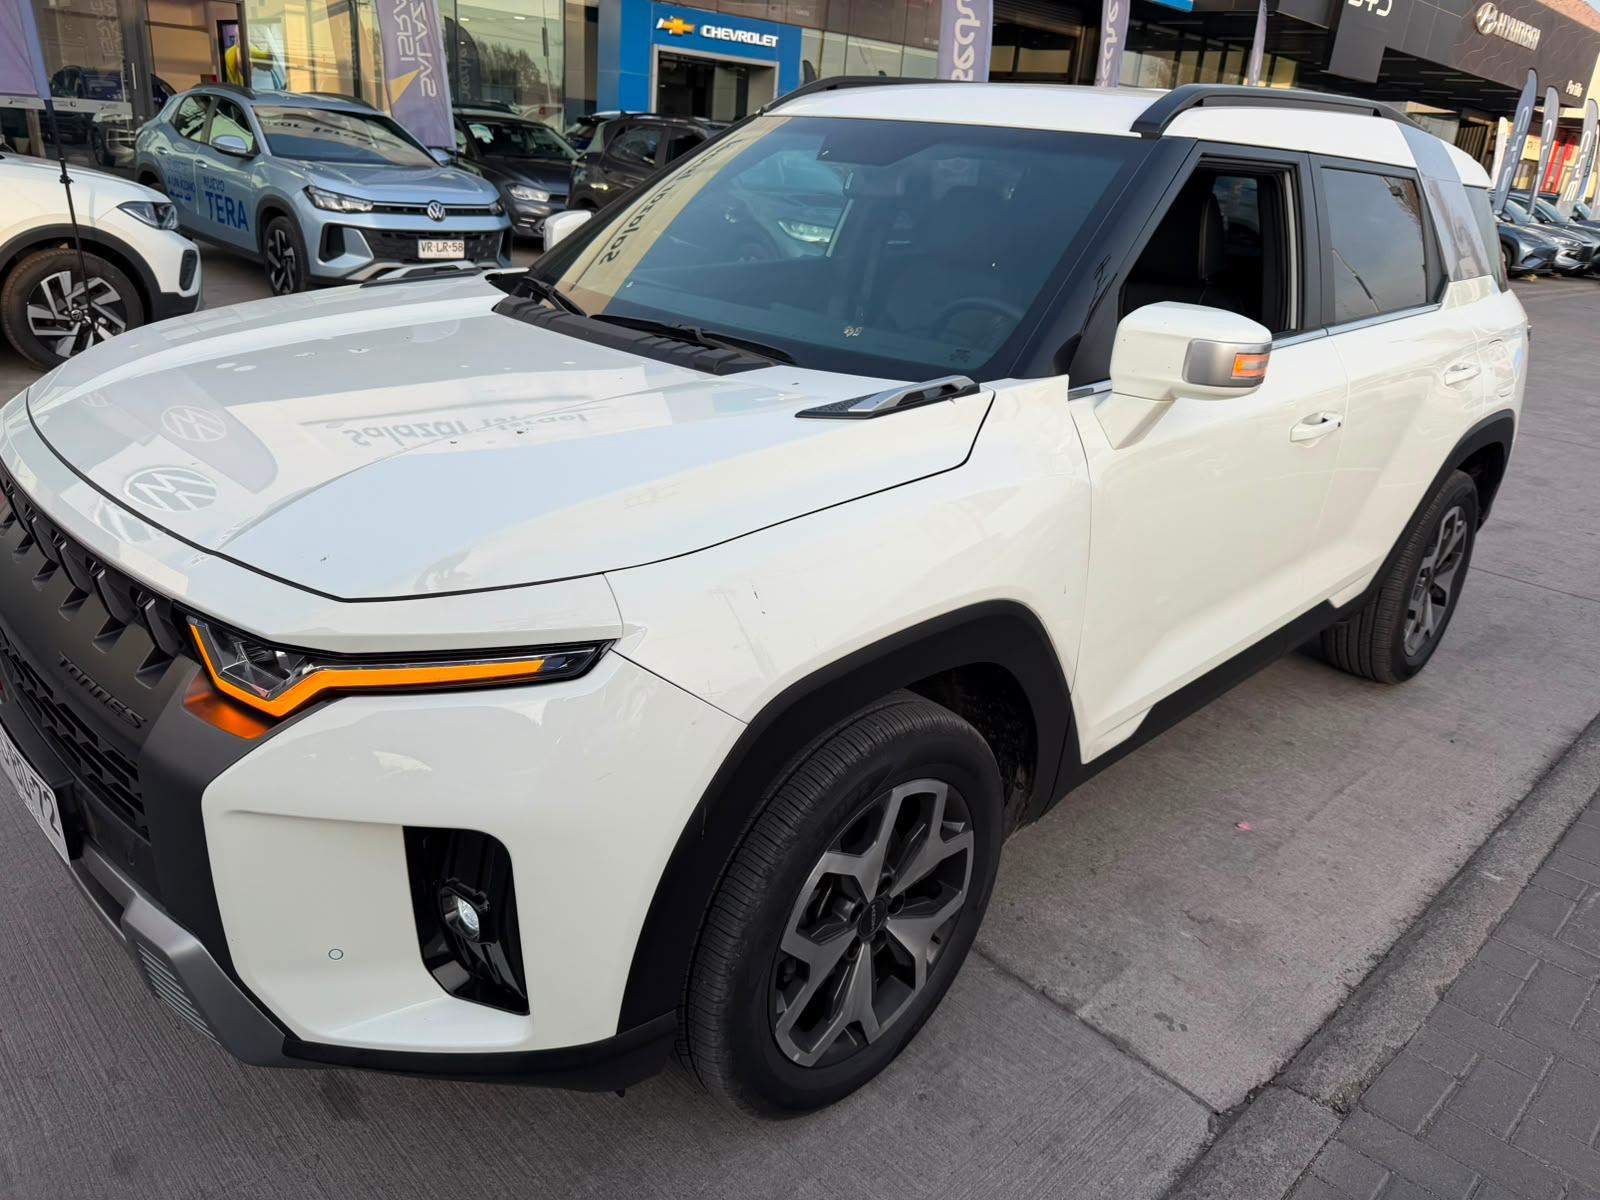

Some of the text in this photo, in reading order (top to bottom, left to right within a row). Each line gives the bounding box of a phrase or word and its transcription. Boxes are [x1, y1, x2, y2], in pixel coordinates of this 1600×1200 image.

[701, 25, 779, 47] CHEVROLET
[205, 191, 250, 232] TERA
[59, 651, 145, 728] TORRES
